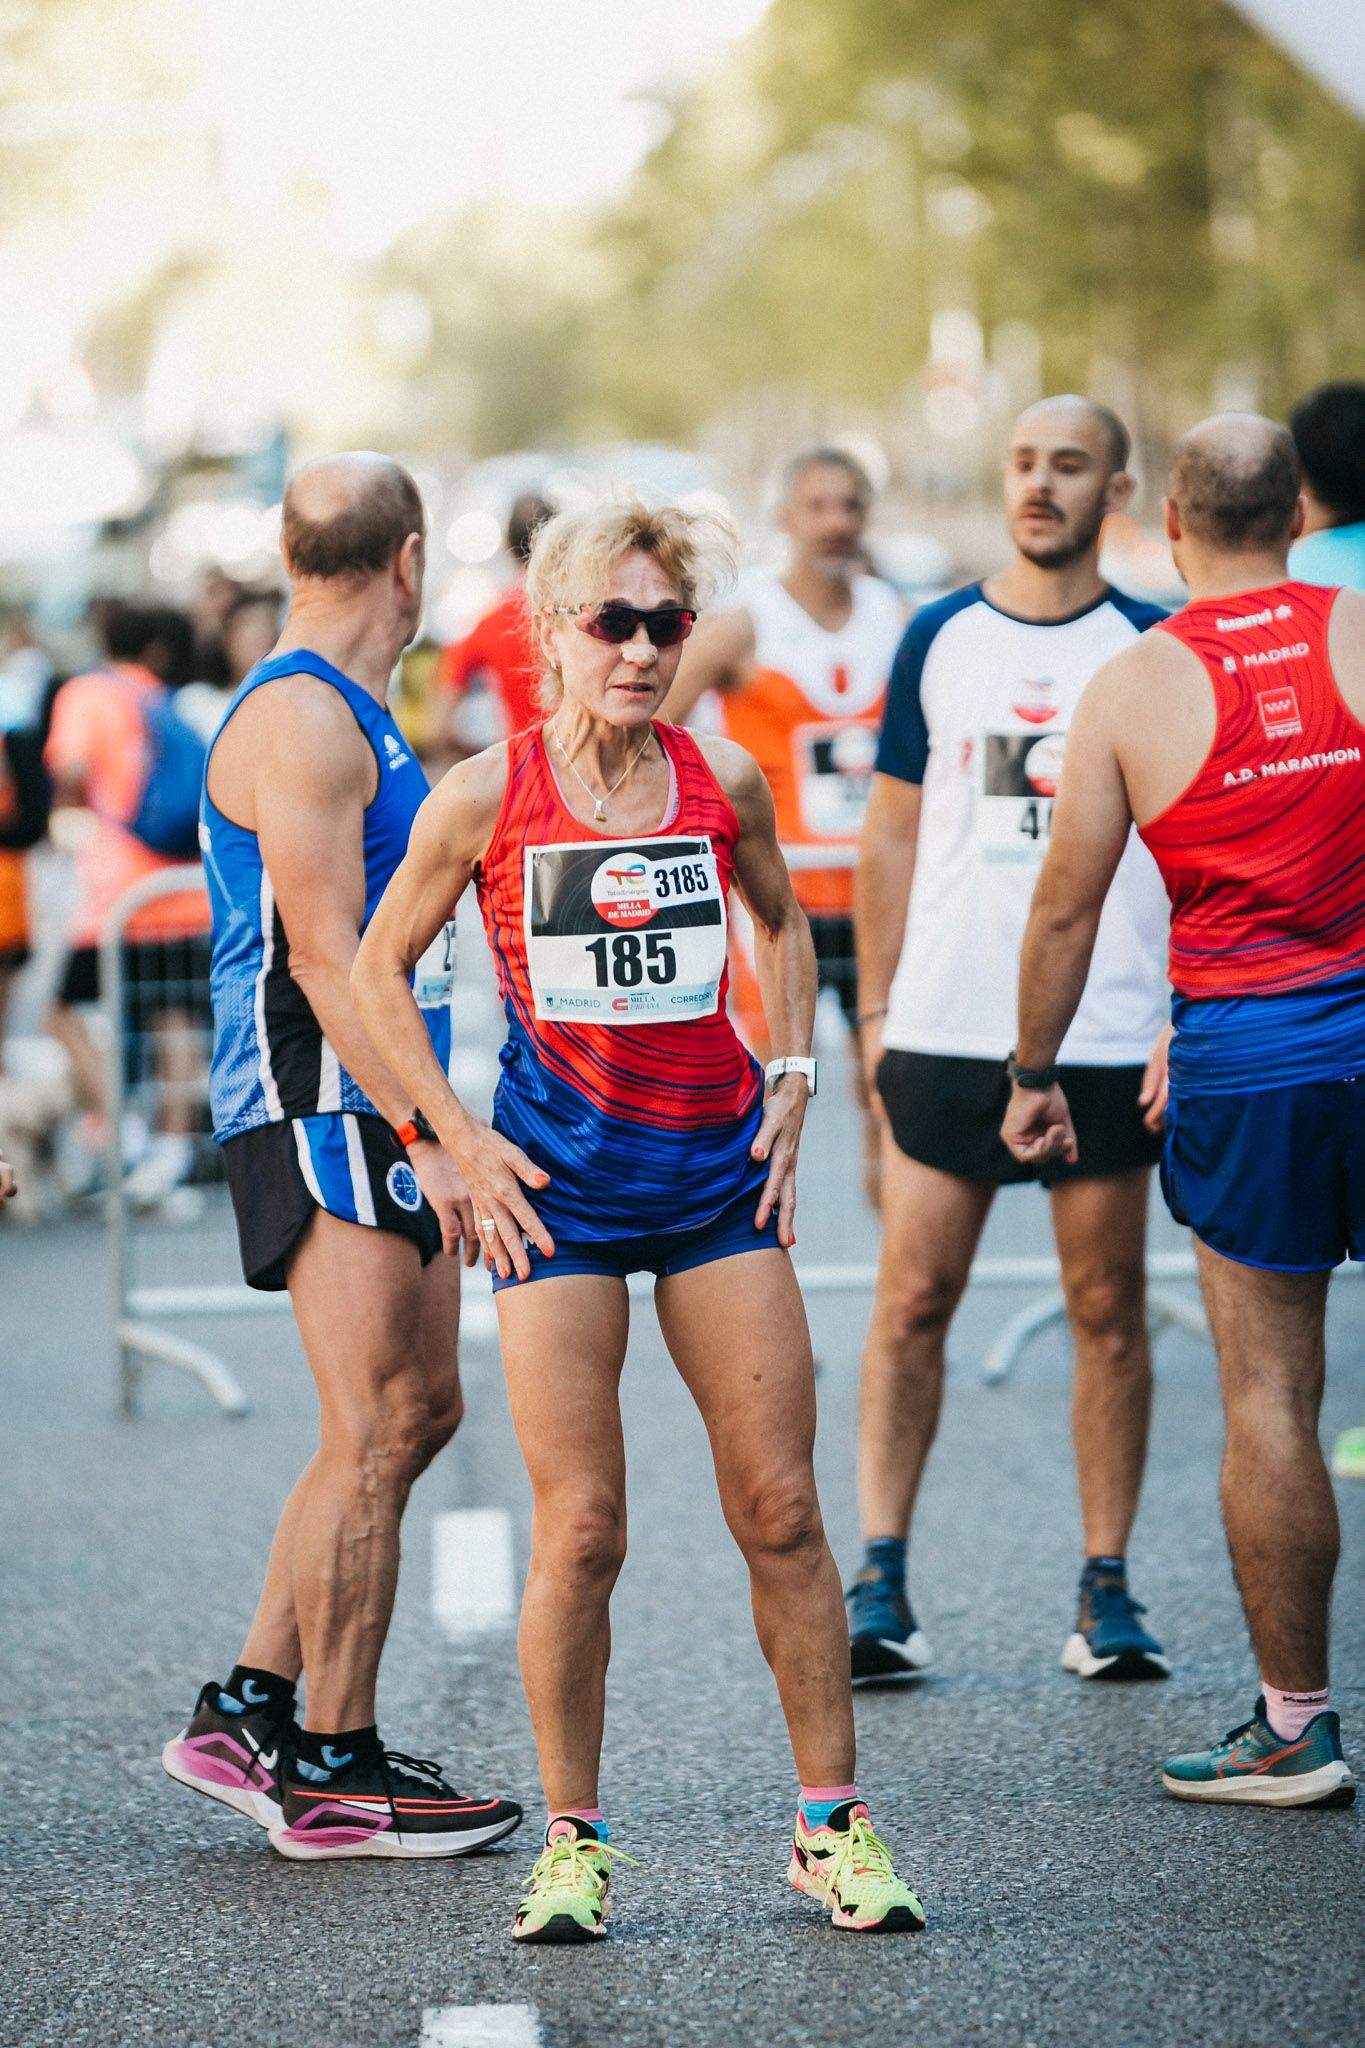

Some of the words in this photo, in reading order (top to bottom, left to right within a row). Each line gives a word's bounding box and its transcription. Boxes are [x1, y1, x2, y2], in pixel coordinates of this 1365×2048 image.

[1243, 642, 1310, 667] MADRID
[1223, 768, 1258, 787] A.D.
[1260, 747, 1361, 777] MARATHON
[1019, 801, 1054, 840] 4
[654, 863, 709, 898] 3185
[607, 911, 619, 919] DE
[620, 908, 652, 918] MADRID
[616, 902, 641, 910] MILLA
[585, 932, 676, 987] 185
[560, 997, 600, 1008] MADRID
